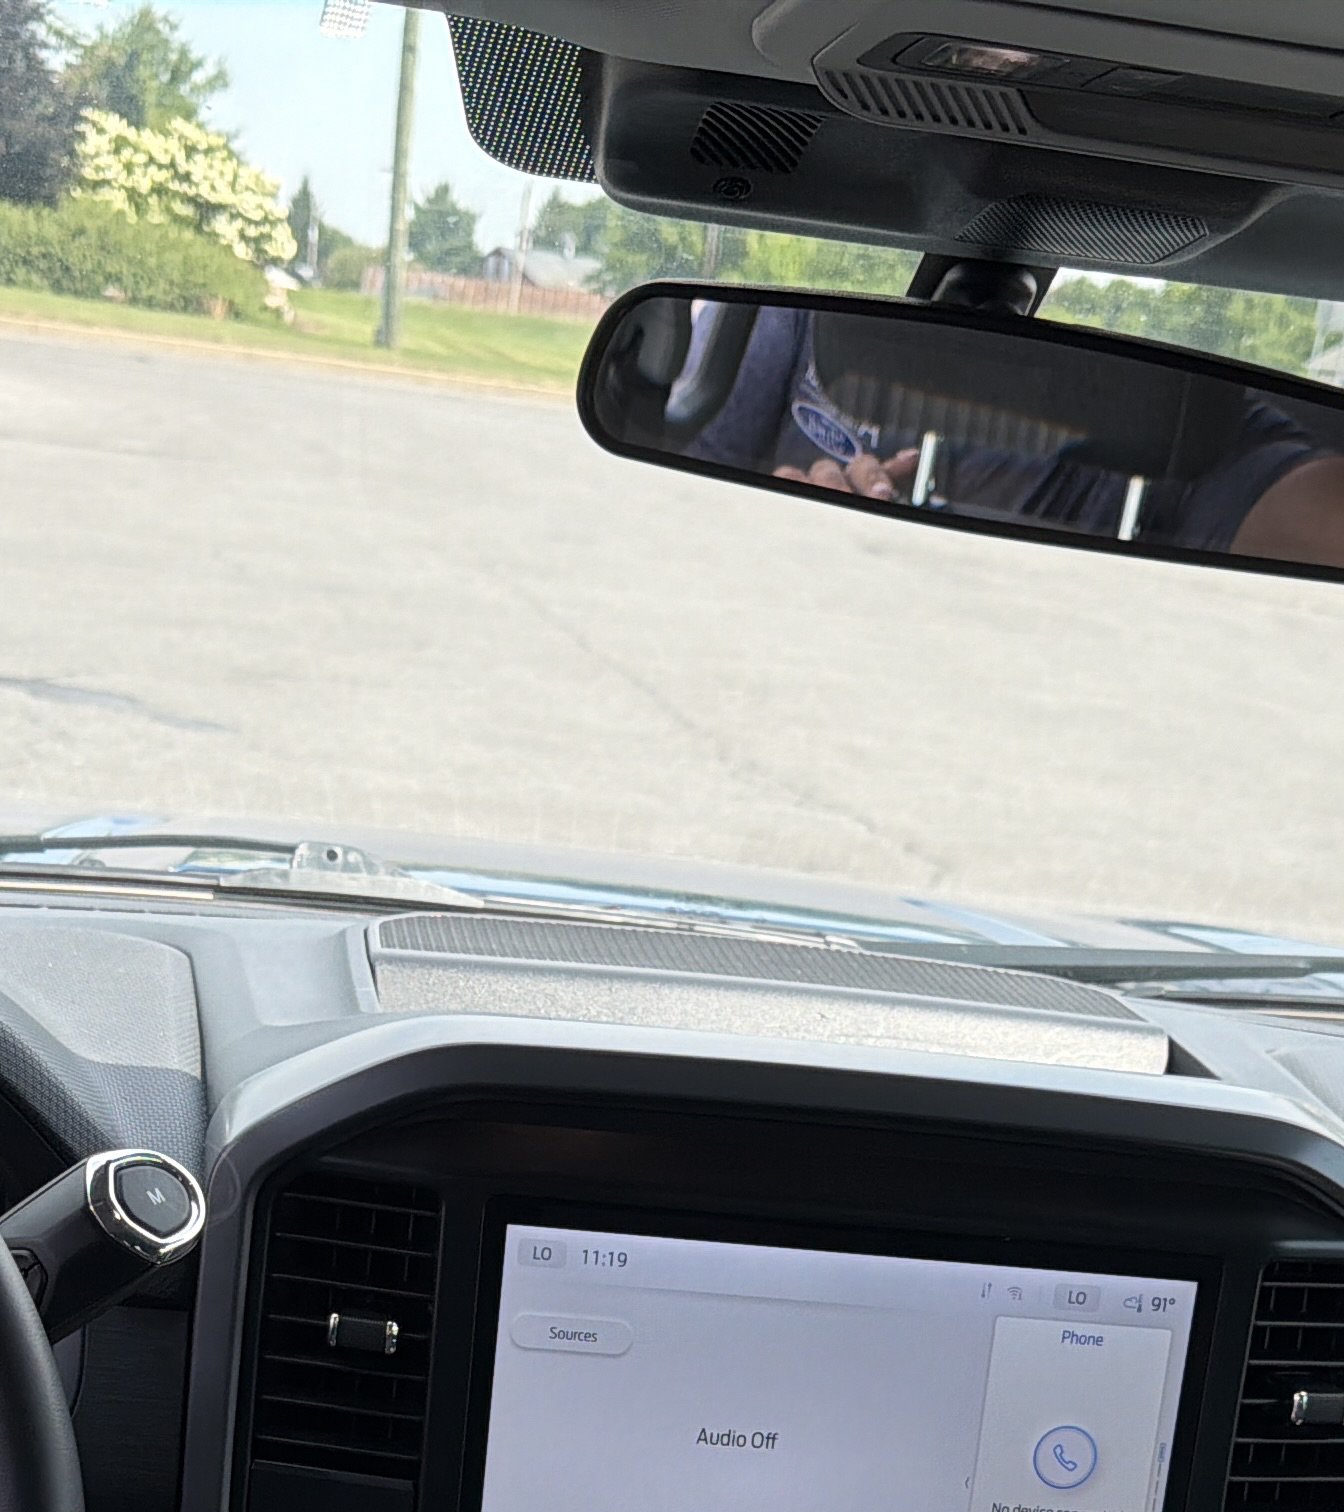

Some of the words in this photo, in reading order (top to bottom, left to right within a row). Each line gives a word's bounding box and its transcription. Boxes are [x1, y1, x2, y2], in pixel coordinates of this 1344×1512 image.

[146, 1187, 166, 1206] M
[532, 1245, 552, 1262] LO
[580, 1248, 629, 1269] 11:19
[1067, 1289, 1088, 1307] LO
[1150, 1296, 1177, 1313] 91°
[549, 1326, 599, 1344] Sources
[1060, 1329, 1105, 1348] Phone
[696, 1427, 747, 1450] Audio
[751, 1429, 779, 1450] Off
